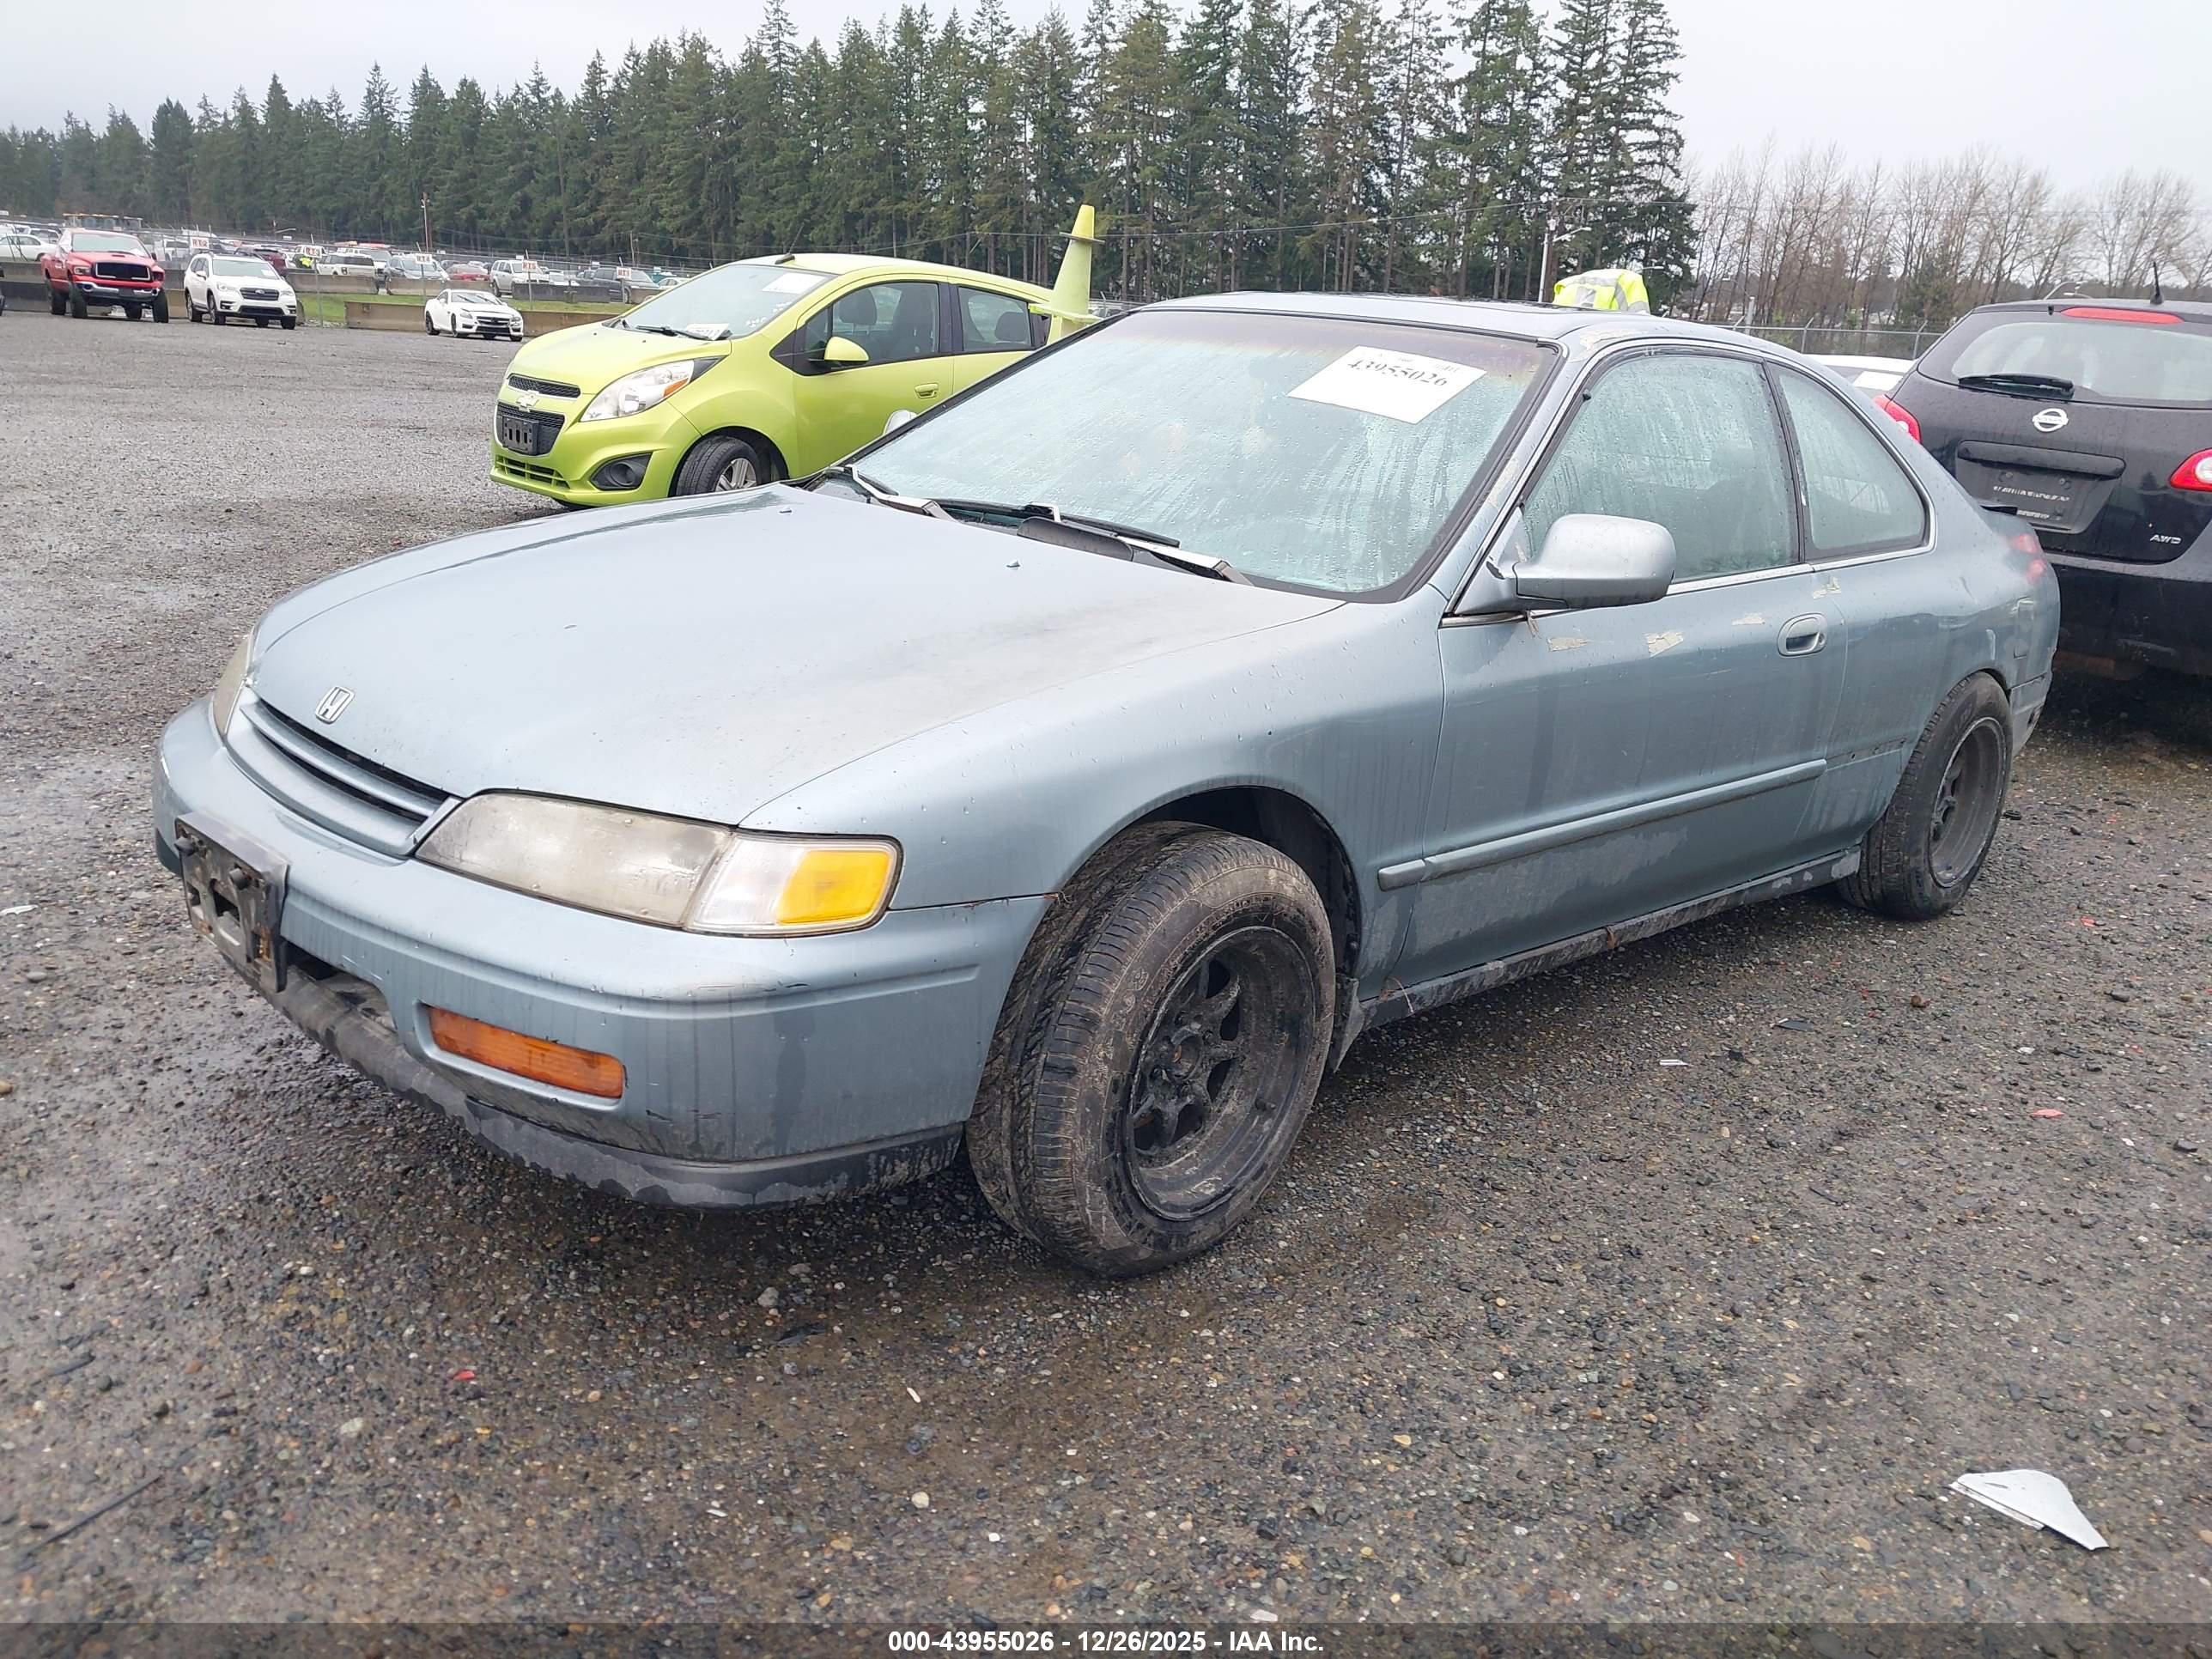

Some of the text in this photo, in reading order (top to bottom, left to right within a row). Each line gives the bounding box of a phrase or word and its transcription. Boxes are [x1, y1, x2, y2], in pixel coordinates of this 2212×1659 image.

[192, 238, 208, 247] RT2
[1346, 358, 1448, 386] 43955026
[2149, 533, 2182, 544] AWD
